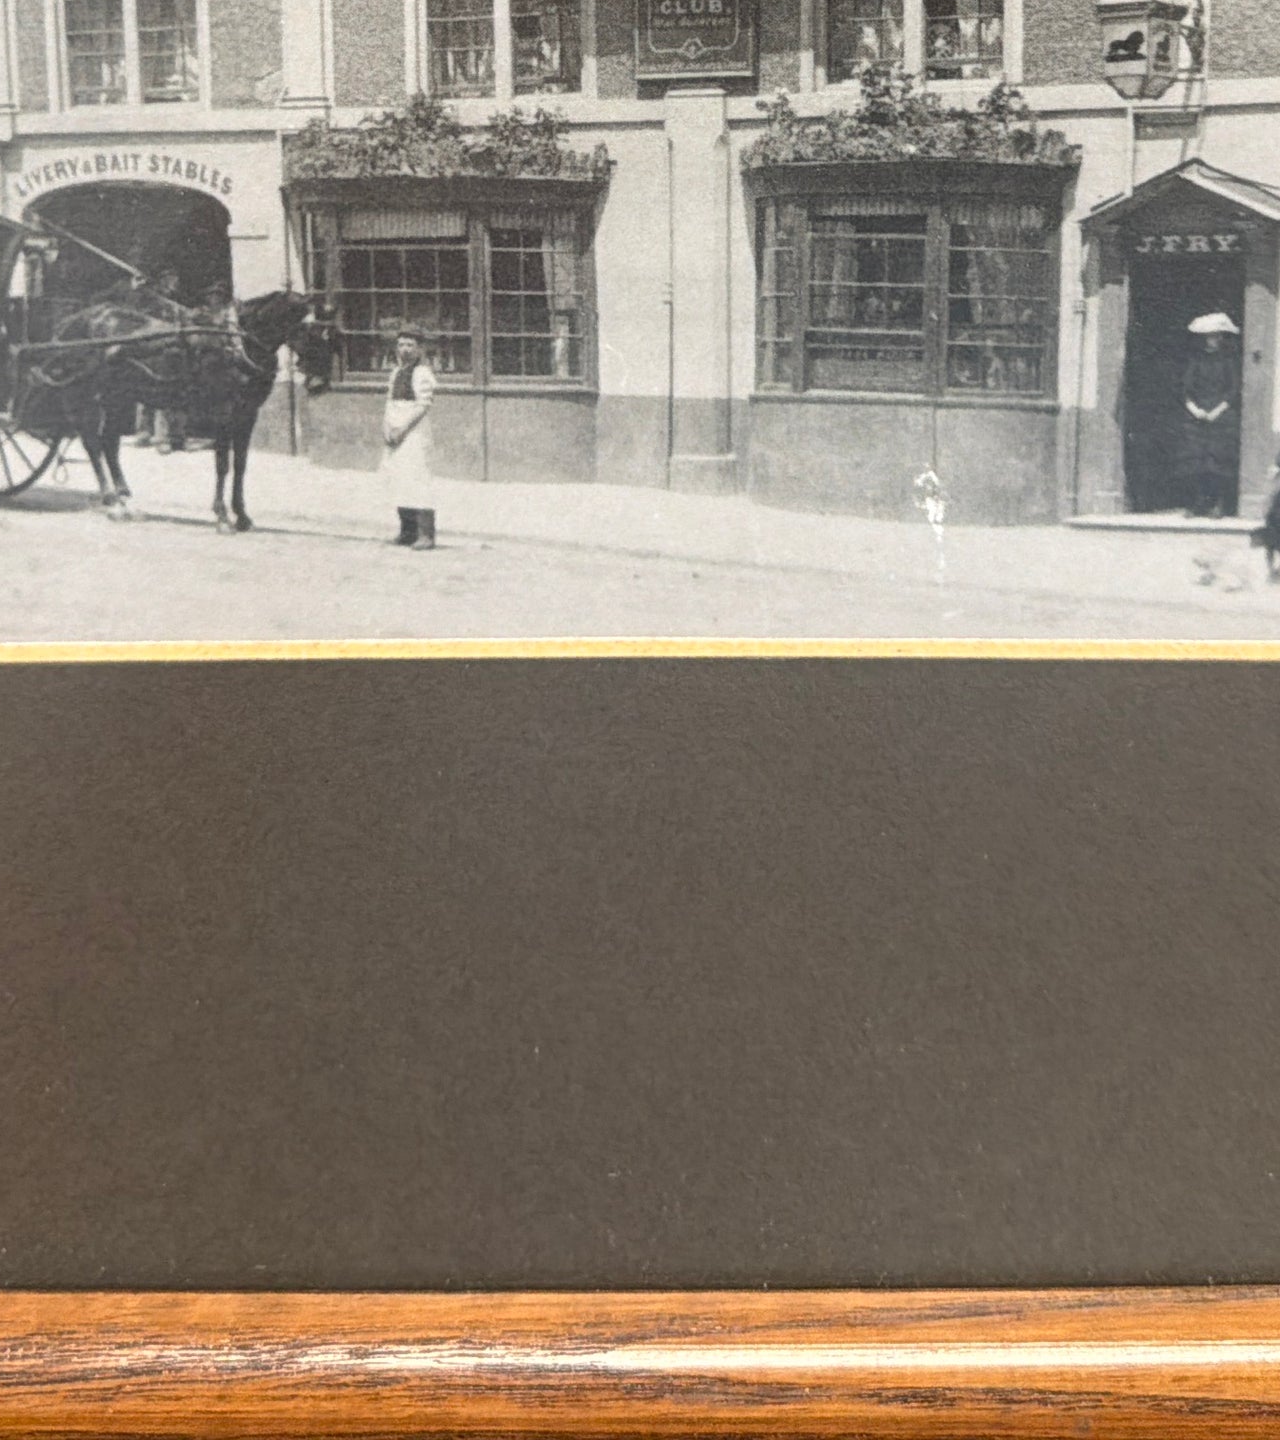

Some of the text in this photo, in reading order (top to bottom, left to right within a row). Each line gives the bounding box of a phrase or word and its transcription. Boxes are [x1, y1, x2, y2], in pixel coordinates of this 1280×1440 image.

[15, 157, 79, 197] LIVERY
[94, 153, 142, 173] BAIT
[148, 154, 233, 195] STABLES
